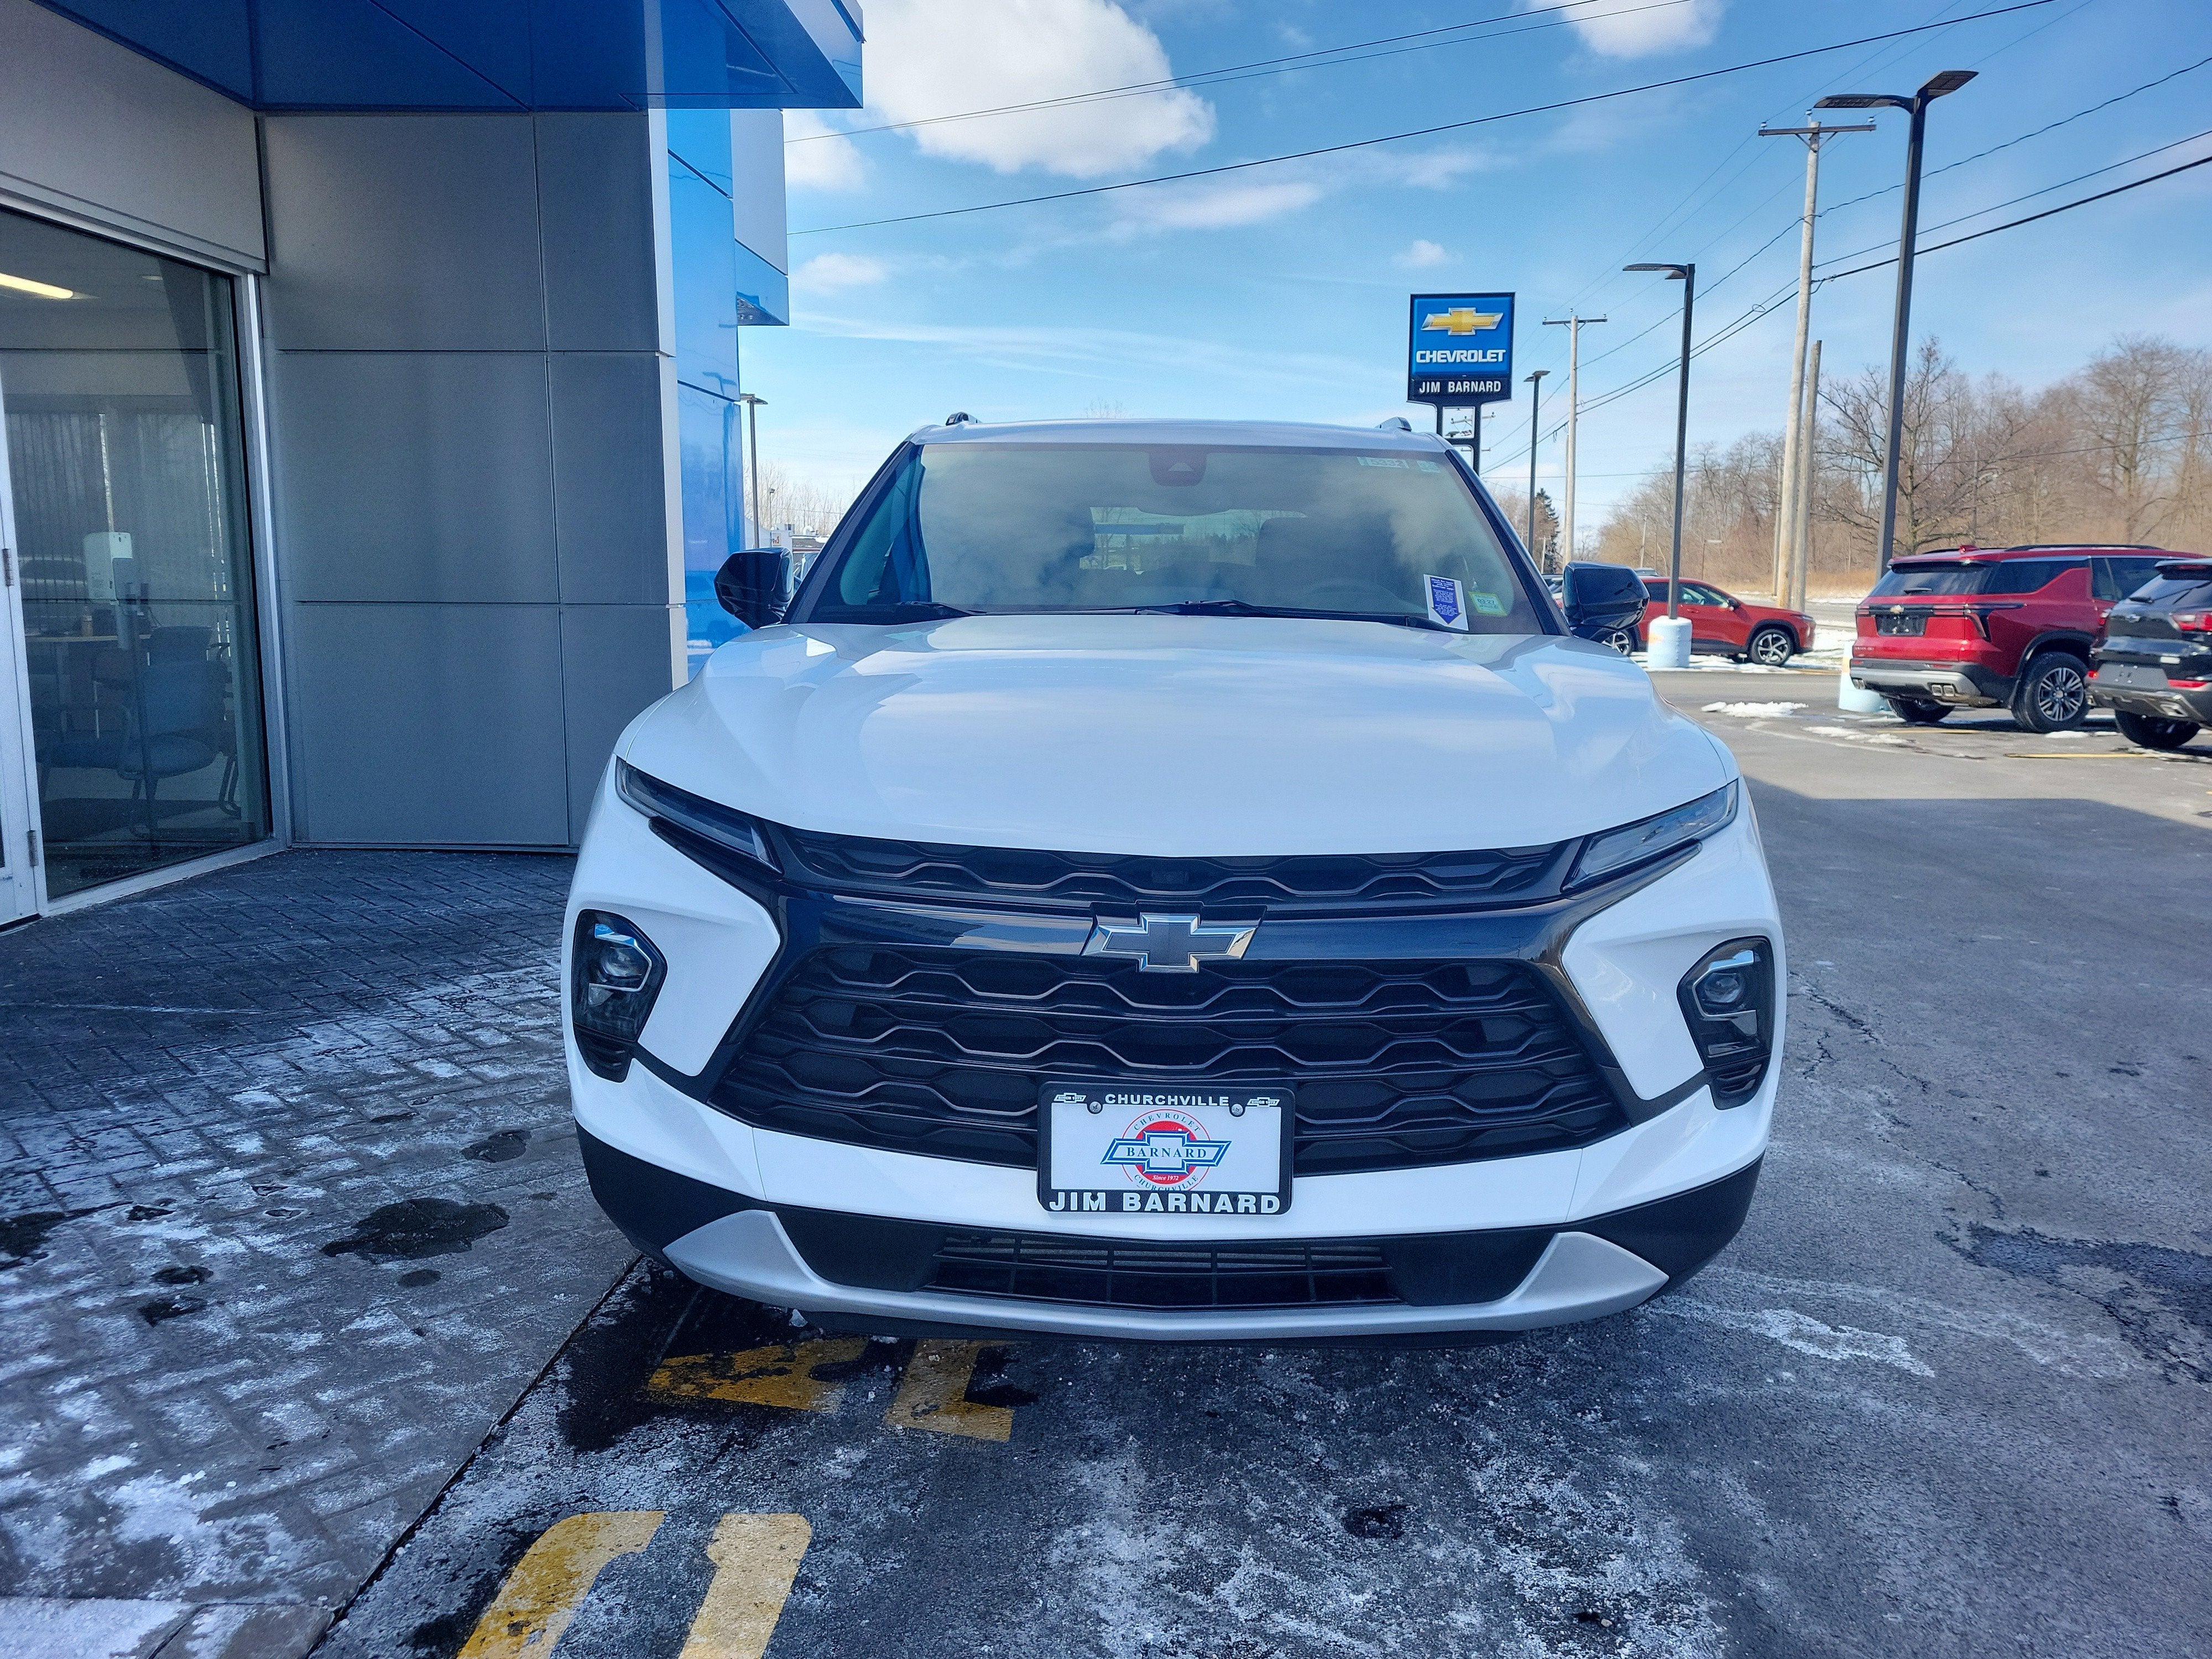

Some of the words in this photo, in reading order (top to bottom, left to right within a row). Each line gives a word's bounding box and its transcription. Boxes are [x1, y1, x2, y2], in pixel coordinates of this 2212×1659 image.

[1416, 350, 1506, 363] CHEVROLET
[1420, 382, 1441, 393] JIM
[1448, 381, 1501, 393] BARNARD
[1105, 1094, 1229, 1106] CHURCHVILLE
[1134, 1113, 1201, 1132] CHEVROLET
[1126, 1147, 1207, 1158] BARNARD
[1050, 1192, 1107, 1211] JIM
[1123, 1192, 1280, 1213] BARNARD
